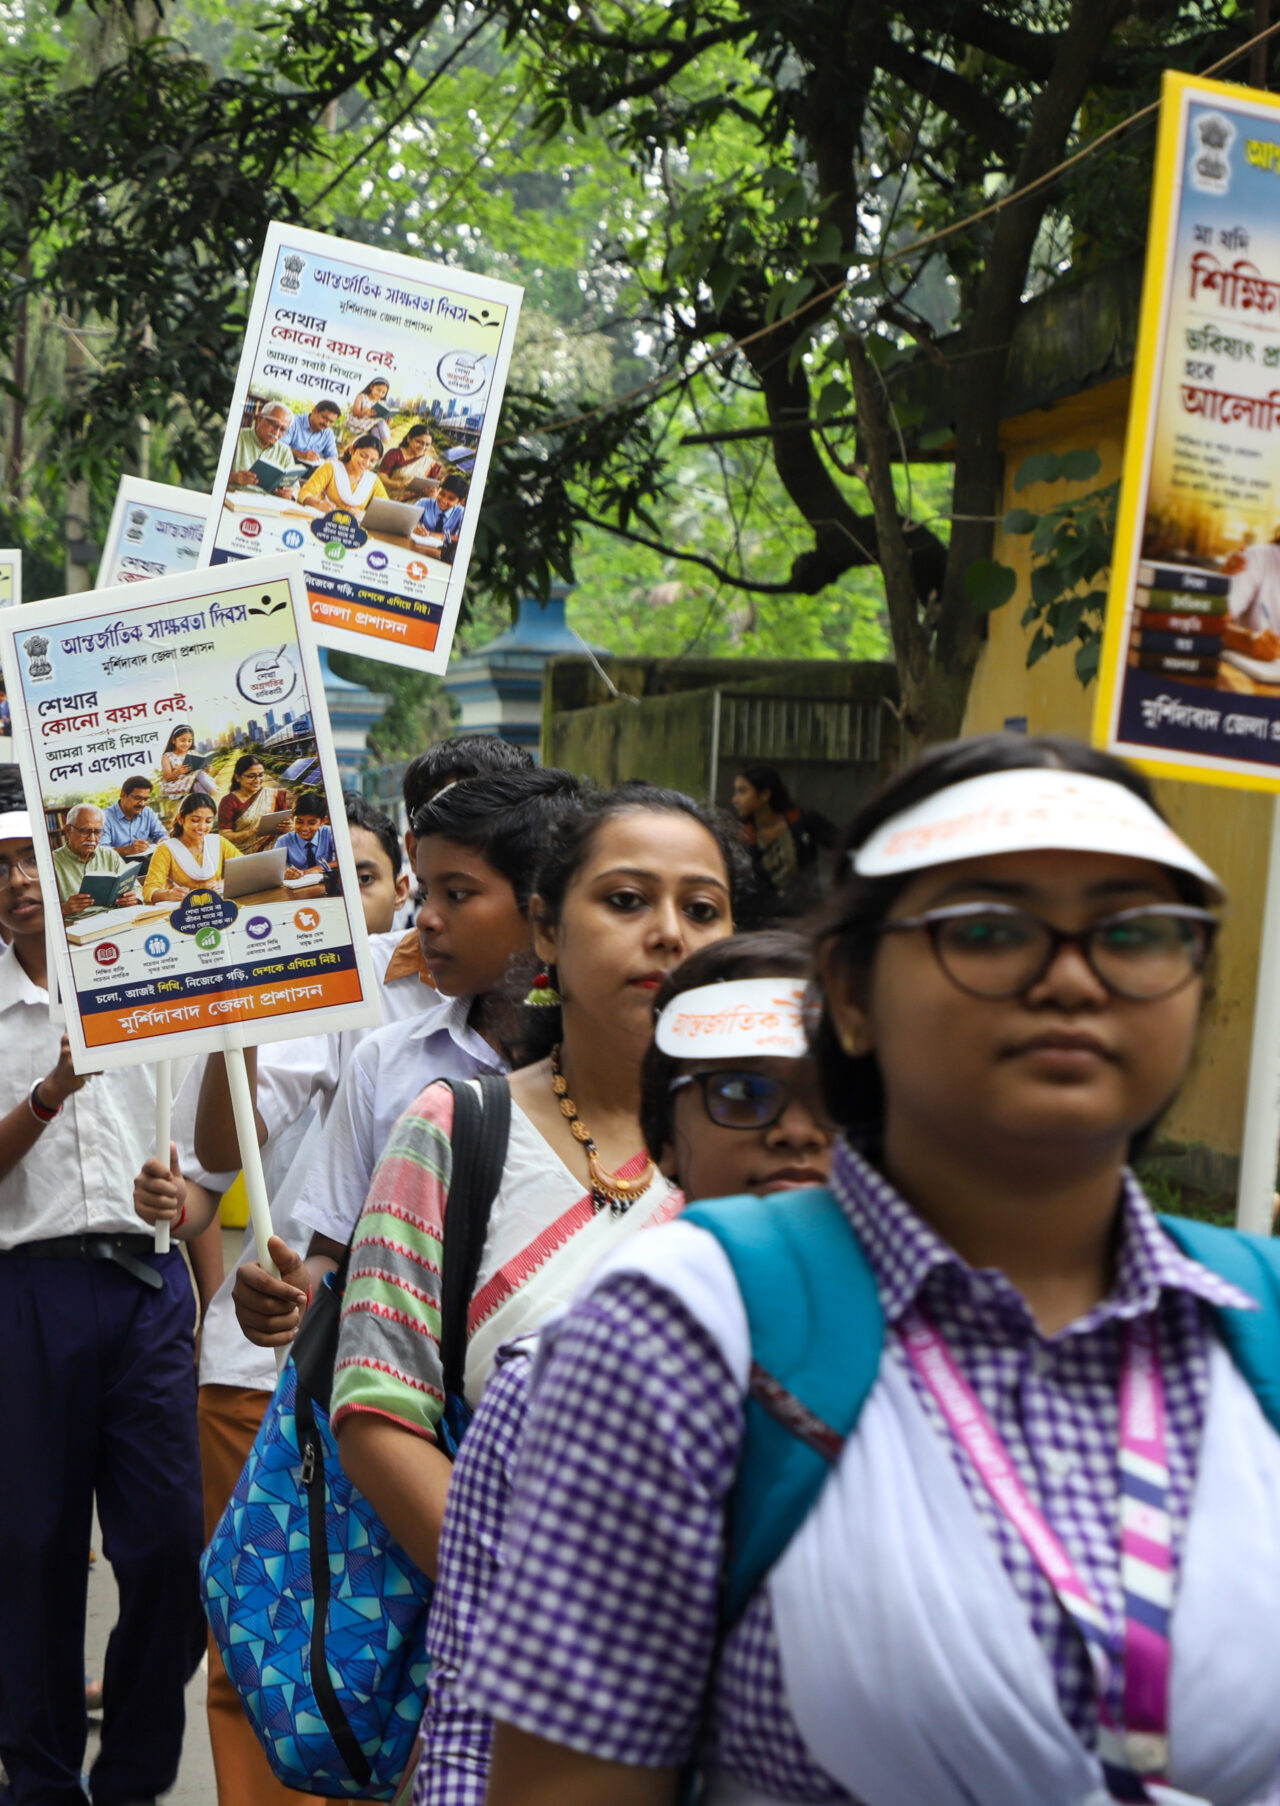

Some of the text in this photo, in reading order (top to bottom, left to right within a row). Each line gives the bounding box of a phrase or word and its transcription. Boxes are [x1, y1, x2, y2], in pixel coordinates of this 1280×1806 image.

[1194, 223, 1250, 252] মা যদি
[313, 267, 468, 323] আন্তর্জাতিক সাক্ষরতা দিবস
[1190, 251, 1280, 315] শিক্ষি
[274, 308, 328, 334] শেখার
[379, 310, 402, 325] জেলা
[404, 315, 433, 334] প্রশাসন
[270, 324, 397, 372] কোনো বয়স নেই,
[262, 363, 352, 398] দেশ এগোবে।
[329, 363, 362, 382] শিখলে
[1185, 359, 1214, 382] হবে
[60, 602, 248, 656] আন্তর্জাতিক সাক্ষরতা দিবস
[312, 602, 408, 636] জেলা প্রশাসন
[102, 641, 216, 676] মুর্শিদাবাদ জেলা প্রশাসন
[37, 690, 99, 717] শেখার
[40, 692, 194, 738] কোনো বয়স নেই,
[1223, 711, 1269, 740] জেলা
[45, 731, 160, 762] আমরা সবাই শিখলে
[49, 750, 153, 782] দেশ এগোবে।
[96, 952, 342, 1004] চলো, আজই শিখি, নিজেকে গড়ি, দেশকে এগিয়ে নিই।
[117, 984, 323, 1034] মুর্শিদাবাদ জেলা প্রশাসন
